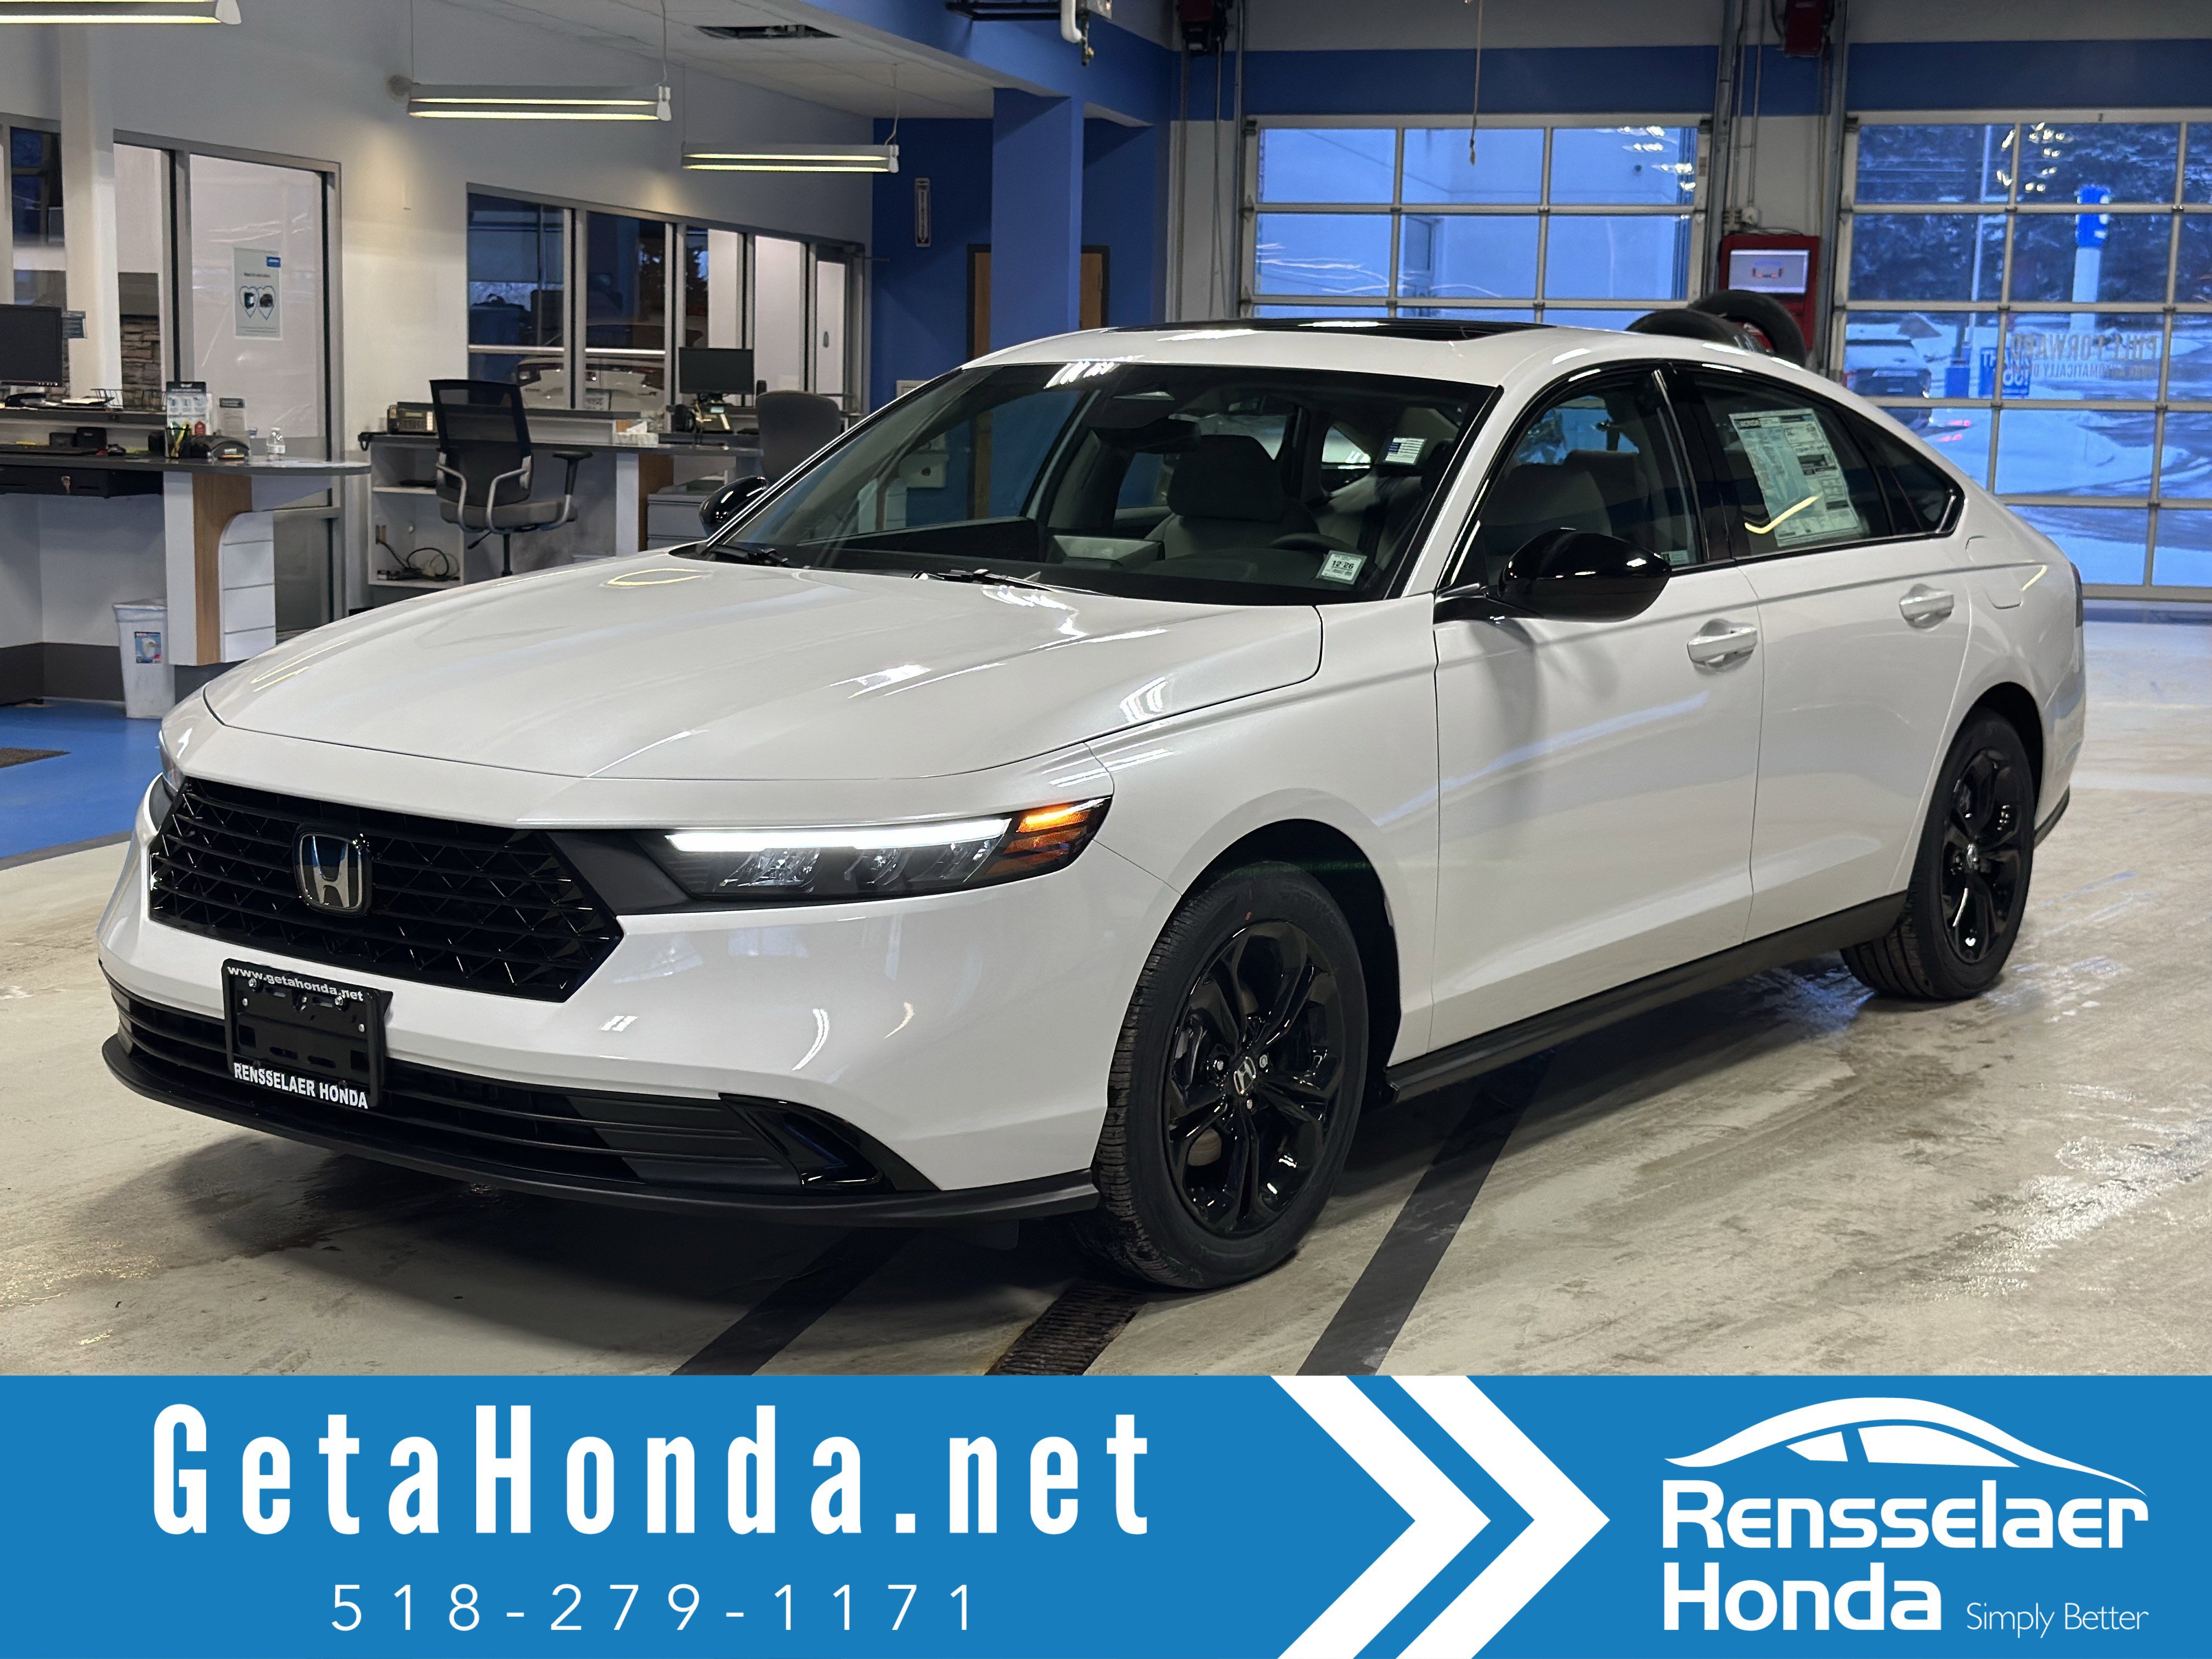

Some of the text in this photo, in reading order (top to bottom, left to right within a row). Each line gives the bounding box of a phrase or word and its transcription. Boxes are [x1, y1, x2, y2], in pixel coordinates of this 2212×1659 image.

[227, 966, 364, 1002] www.getahonda.net
[234, 1062, 368, 1109] RENSSELAER HONDA
